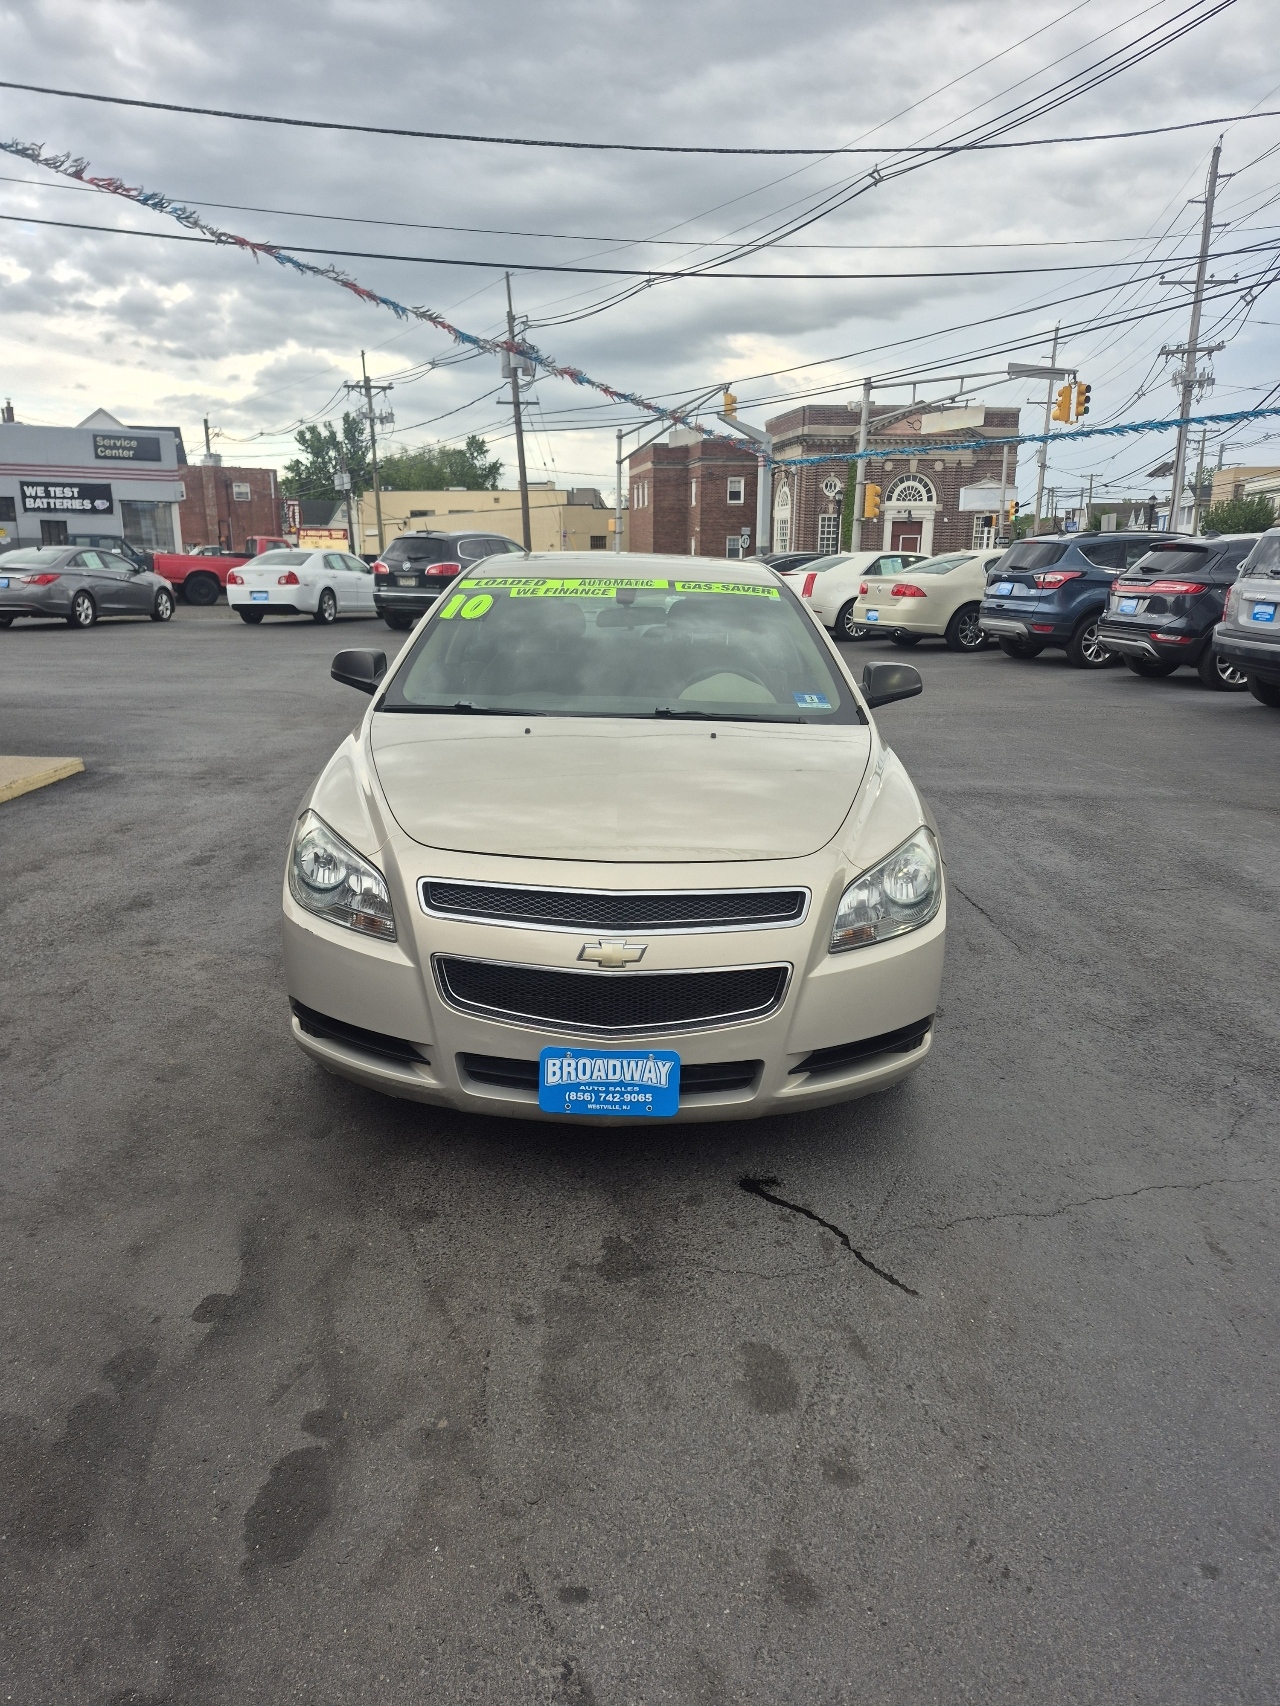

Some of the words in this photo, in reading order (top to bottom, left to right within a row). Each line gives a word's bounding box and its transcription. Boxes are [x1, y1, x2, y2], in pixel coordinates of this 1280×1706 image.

[96, 437, 137, 448] Service
[97, 447, 135, 458] Center
[23, 486, 45, 497] WE
[48, 487, 79, 498] TEST
[25, 498, 92, 510] BATTERIES
[474, 579, 547, 587] LOADED
[578, 579, 654, 587] AUTOMATIC
[515, 588, 540, 596] WE
[543, 588, 611, 596] FINANCE
[439, 594, 494, 620] 10
[545, 1057, 674, 1088] BROADWAY
[565, 1091, 595, 1103] (856)
[599, 1093, 653, 1102] 742-9065
